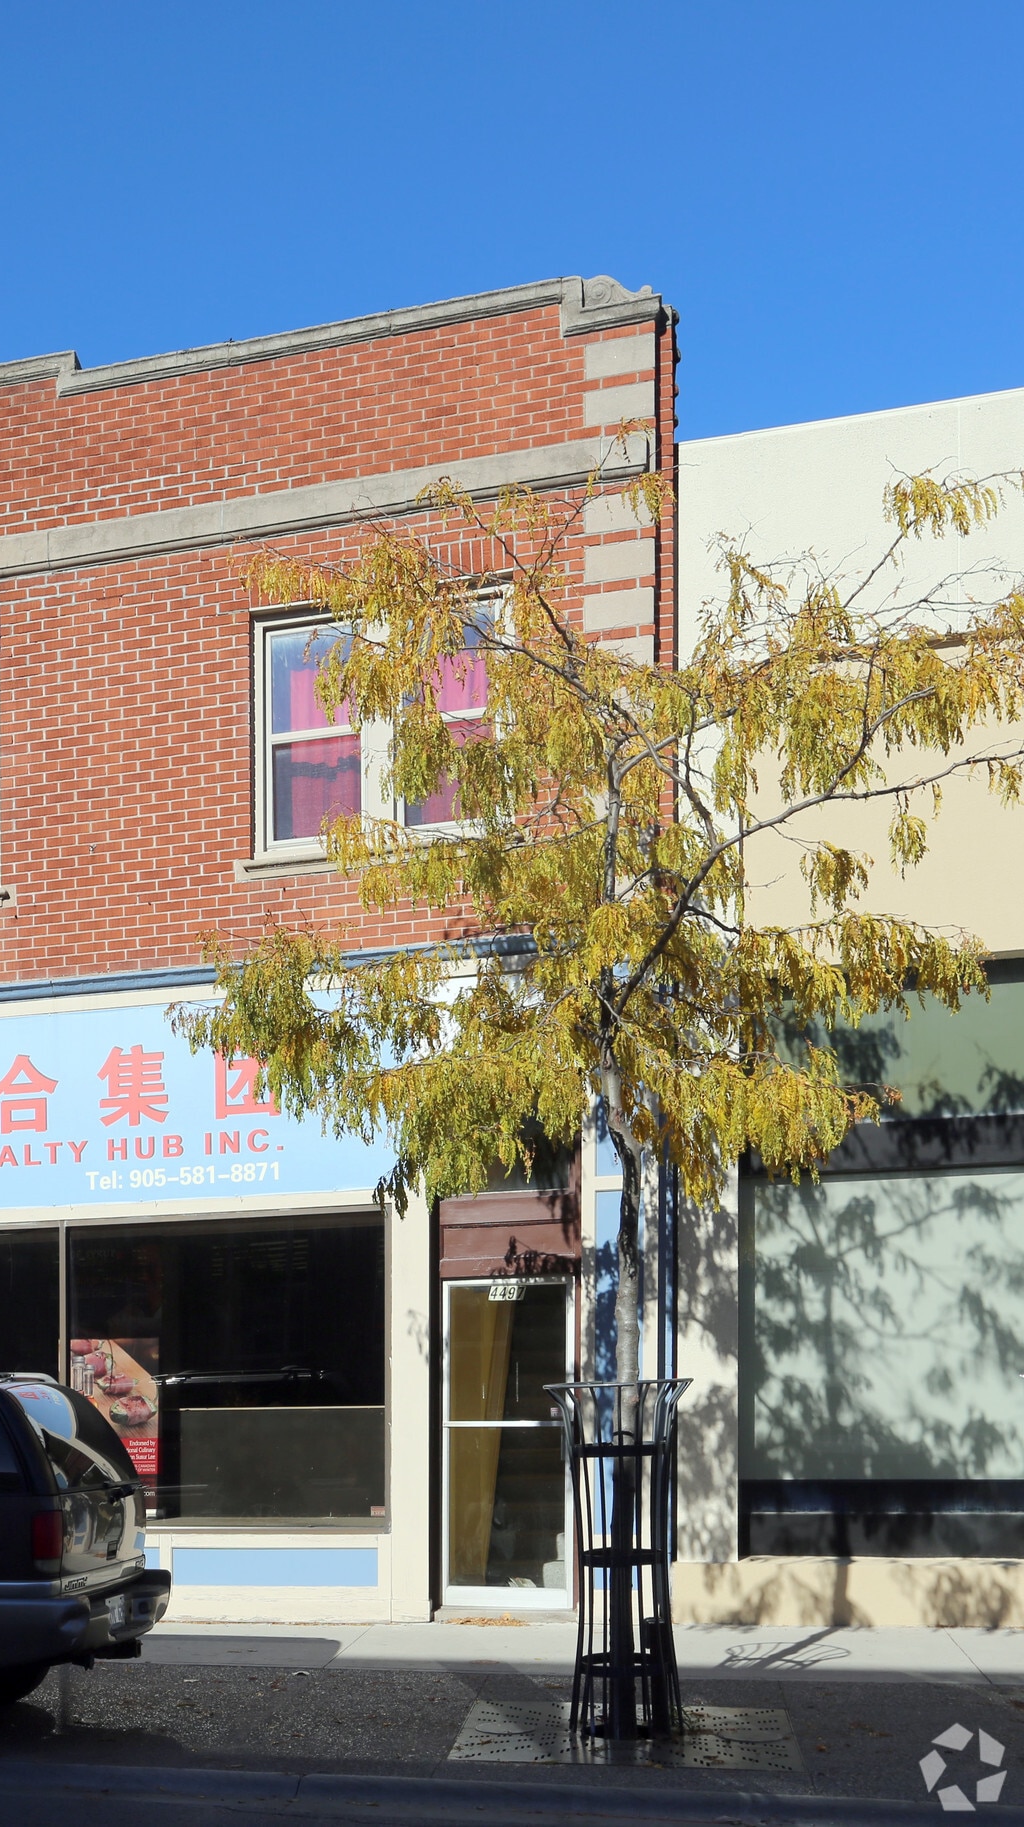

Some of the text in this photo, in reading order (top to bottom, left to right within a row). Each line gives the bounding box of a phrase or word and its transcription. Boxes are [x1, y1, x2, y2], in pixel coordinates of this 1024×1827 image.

[107, 1134, 184, 1161] HUB
[205, 1128, 285, 1156] INC.
[85, 1161, 281, 1190] Tel: 905-581-8871
[490, 1286, 525, 1299] 4497
